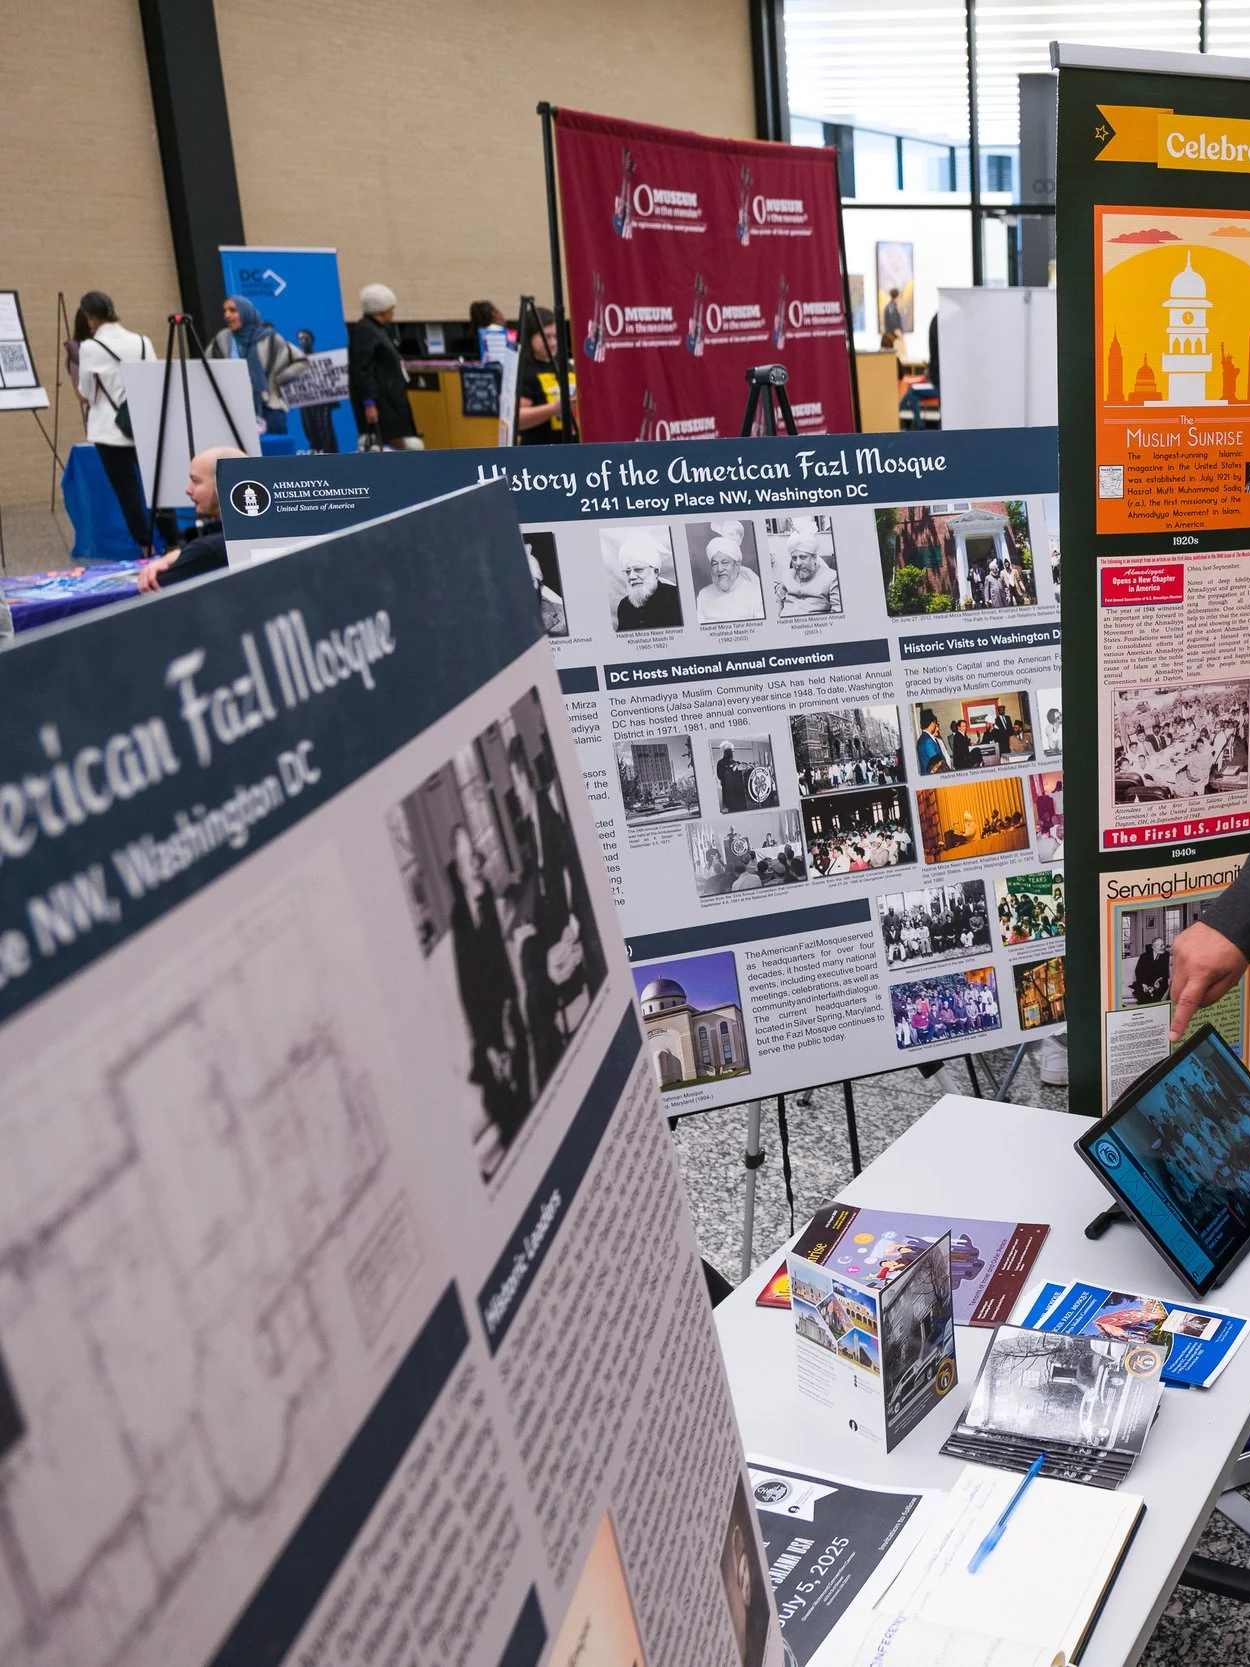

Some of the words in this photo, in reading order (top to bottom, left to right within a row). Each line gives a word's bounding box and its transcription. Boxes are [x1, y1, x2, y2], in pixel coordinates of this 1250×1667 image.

[1180, 415, 1194, 425] The
[477, 464, 577, 497] Hstory
[586, 459, 613, 492] of
[619, 458, 660, 486] the
[667, 456, 791, 484] American
[795, 450, 849, 480] Fazl
[856, 447, 947, 479] Mosque
[1146, 475, 1185, 483] established
[1200, 474, 1213, 483] July
[1233, 473, 1241, 481] by
[273, 480, 330, 490] AHMADIYYA
[274, 490, 310, 499] MUSLIM
[313, 487, 370, 497] COMMUNITY
[276, 505, 300, 513] United
[301, 504, 319, 512] States
[320, 503, 326, 511] of
[327, 502, 355, 510] America
[580, 497, 620, 512] 2141
[626, 493, 670, 512] Leroy
[674, 491, 715, 507] Place
[719, 490, 752, 506] NW,
[755, 486, 842, 504] Washington
[846, 484, 868, 498] DC
[1173, 536, 1199, 545] 1920s
[1112, 577, 1131, 585] Opens
[1152, 575, 1175, 583] Chapter
[1124, 568, 1165, 577] Ahmadiyyat
[1136, 584, 1160, 592] America
[904, 640, 945, 654] Historic
[946, 638, 975, 650] Visits
[977, 637, 988, 647] to
[990, 629, 1050, 645] Washington
[1052, 630, 1061, 639] D
[610, 671, 630, 683] DC
[633, 668, 668, 680] Hosts
[671, 661, 722, 677] National
[726, 657, 766, 671] Annual
[769, 652, 834, 667] Convention
[904, 668, 919, 676] The
[956, 661, 983, 672] Capital
[986, 660, 1000, 668] and
[1003, 658, 1015, 666] the
[1018, 654, 1051, 664] American
[164, 631, 277, 770] Fazl
[264, 606, 397, 709] Mosque
[609, 698, 626, 706] The
[630, 692, 678, 704] Ahmadiyya
[682, 689, 712, 698] Muslim
[716, 683, 764, 695] Community
[768, 680, 787, 690] USA
[790, 679, 805, 688] has
[808, 677, 825, 685] held
[829, 673, 862, 683] National
[865, 670, 892, 679] Annual
[906, 689, 919, 697] the
[920, 684, 962, 697] Ahmadiyya
[963, 681, 990, 691] Muslim
[991, 677, 1033, 688] Community.
[610, 706, 665, 717] Conventions
[667, 702, 692, 713] (Jalsa
[694, 698, 726, 709] Salana)
[727, 695, 750, 705] every
[750, 695, 769, 703] year
[771, 692, 792, 700] since
[793, 688, 815, 698] 1948.
[848, 680, 893, 692] Washington
[111, 772, 285, 900] Washington
[277, 738, 322, 798] DC
[1112, 832, 1137, 844] The
[1144, 827, 1177, 841] First
[1184, 824, 1209, 837] U.S.
[1215, 817, 1250, 832] Jalsa
[1171, 848, 1196, 858] 1940s
[1107, 864, 1241, 899] ServingHumanit
[758, 1046, 781, 1057] serve
[782, 1042, 796, 1052] the
[797, 1038, 822, 1050] public
[823, 1034, 847, 1044] today.
[807, 1242, 827, 1263] nrise
[878, 1521, 900, 1551] Invitation
[898, 1511, 905, 1522] to
[904, 1497, 917, 1517] follow
[787, 1537, 815, 1554] USA
[797, 1582, 821, 1593] 5,
[810, 1536, 850, 1577] 2025
